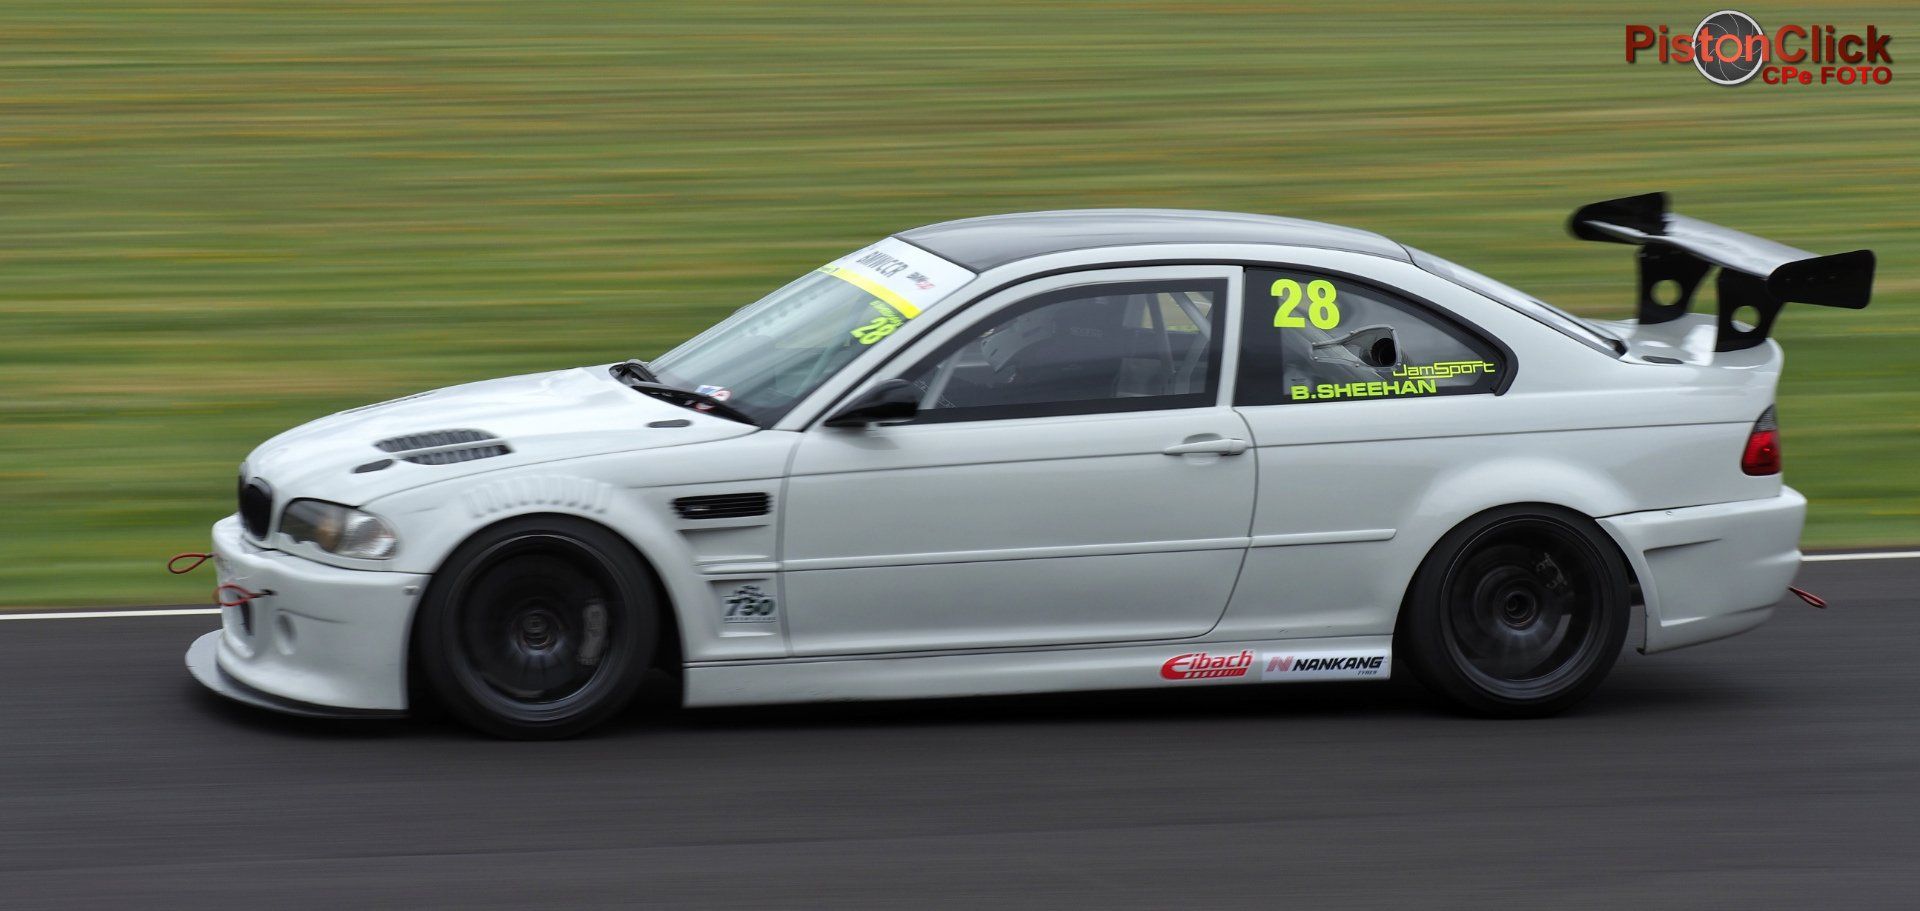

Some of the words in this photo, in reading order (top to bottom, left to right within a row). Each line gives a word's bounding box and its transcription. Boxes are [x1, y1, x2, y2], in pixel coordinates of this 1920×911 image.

[1271, 279, 1340, 330] 28
[850, 316, 895, 345] 28
[1392, 360, 1496, 379] JamSport
[1291, 380, 1437, 400] B.SHEEHAN
[1160, 650, 1252, 679] Eibach
[1292, 656, 1384, 671] NANKANG
